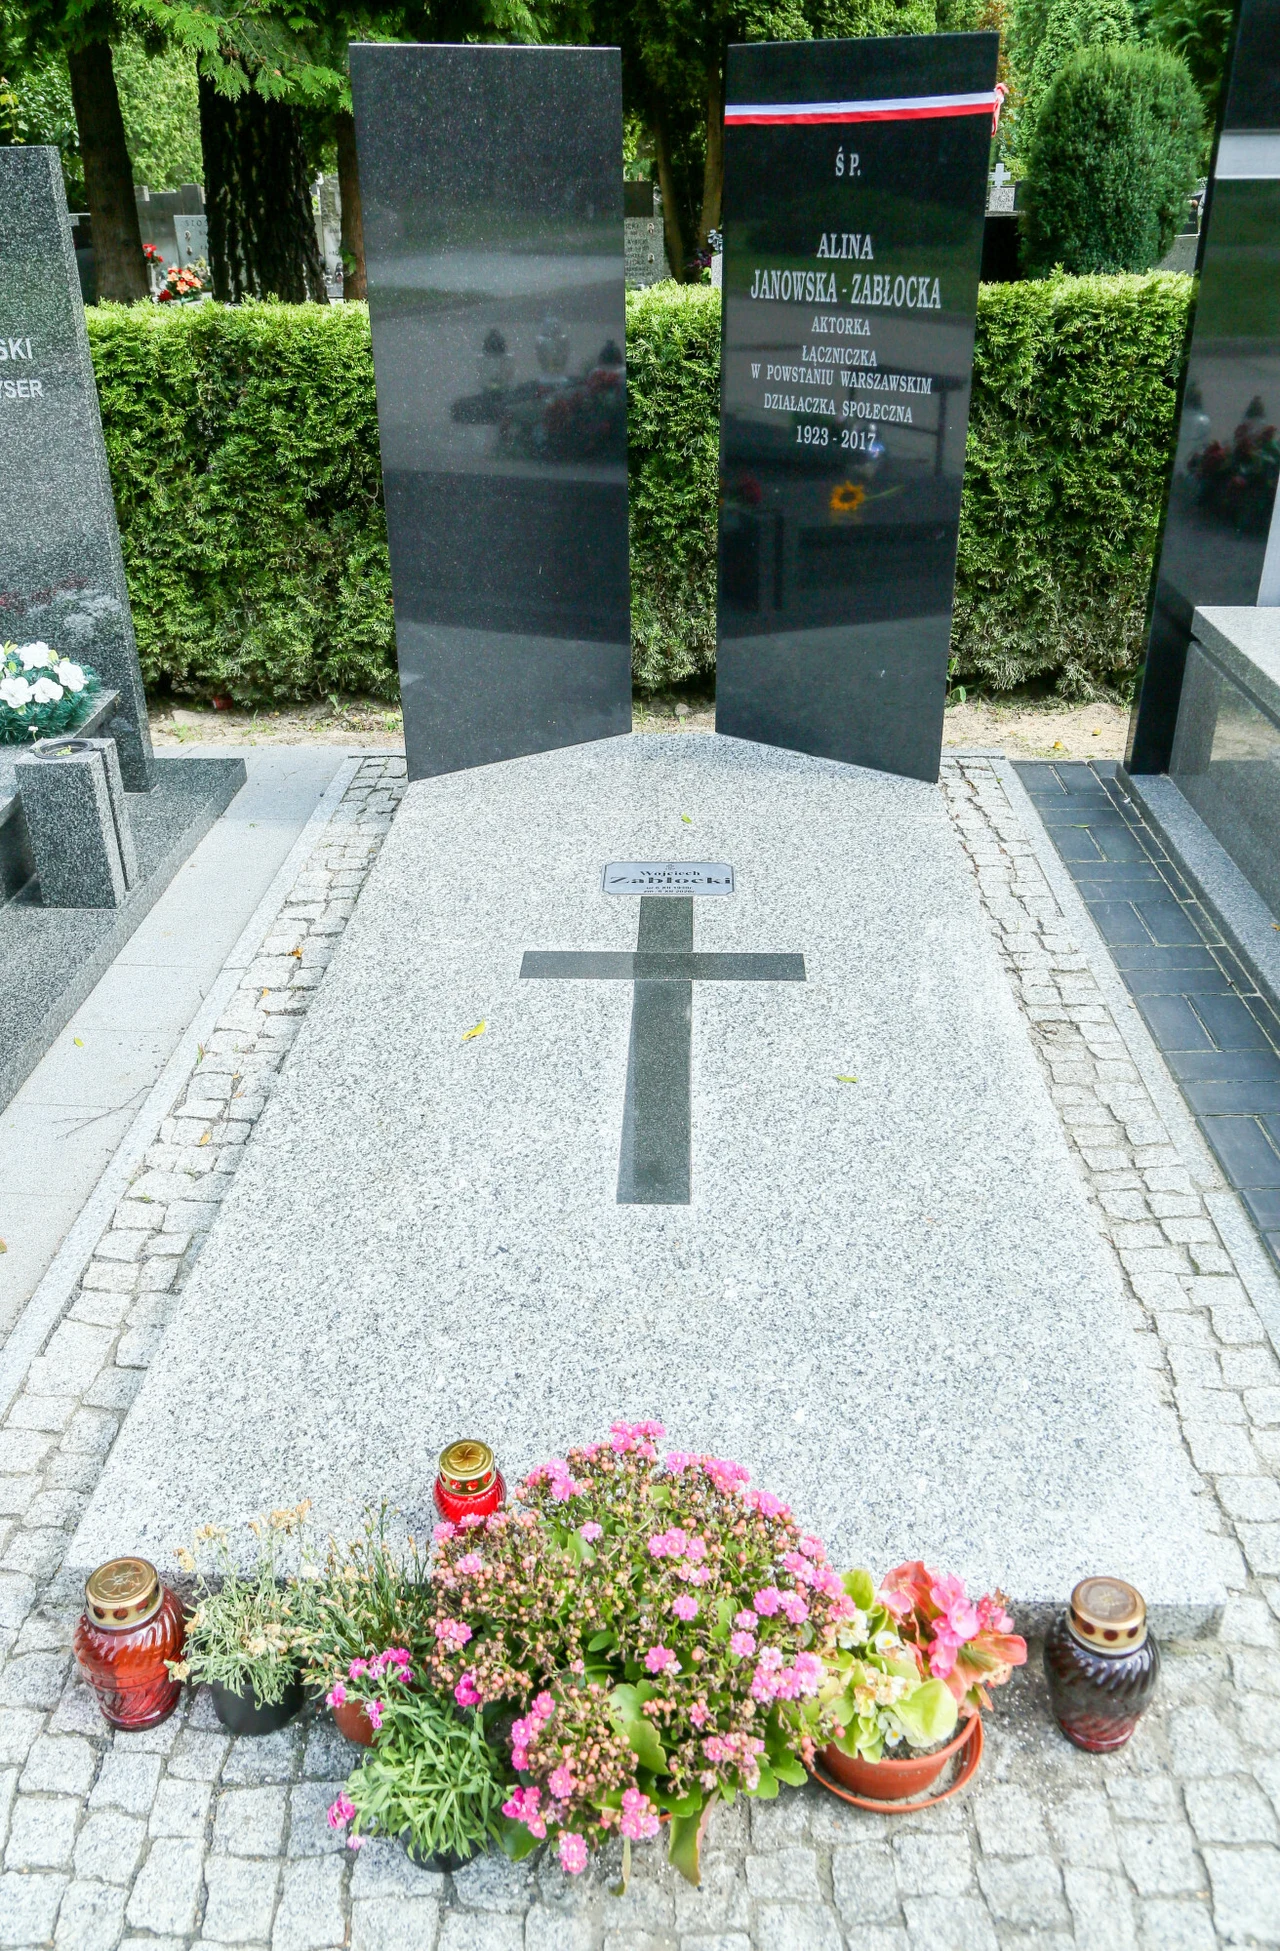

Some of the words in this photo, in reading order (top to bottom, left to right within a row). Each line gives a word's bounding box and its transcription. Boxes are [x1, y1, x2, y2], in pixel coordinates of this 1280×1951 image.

[849, 153, 861, 176] P.
[816, 233, 874, 260] ALINA
[750, 269, 838, 303] JANOWSKA
[851, 273, 942, 309] ZABŁOCKA
[811, 316, 871, 336] AKTORKA
[802, 345, 878, 367] ŁĄCZNICZKA
[0, 379, 45, 398] SER
[751, 363, 761, 379] W
[766, 365, 834, 386] POWSTANIU
[840, 370, 933, 395] WARSZAWSKIM
[763, 393, 836, 415] DZIAŁACZKA
[842, 401, 913, 423] SPOŁECZNA
[796, 425, 829, 446] 1923
[841, 430, 876, 450] 2017
